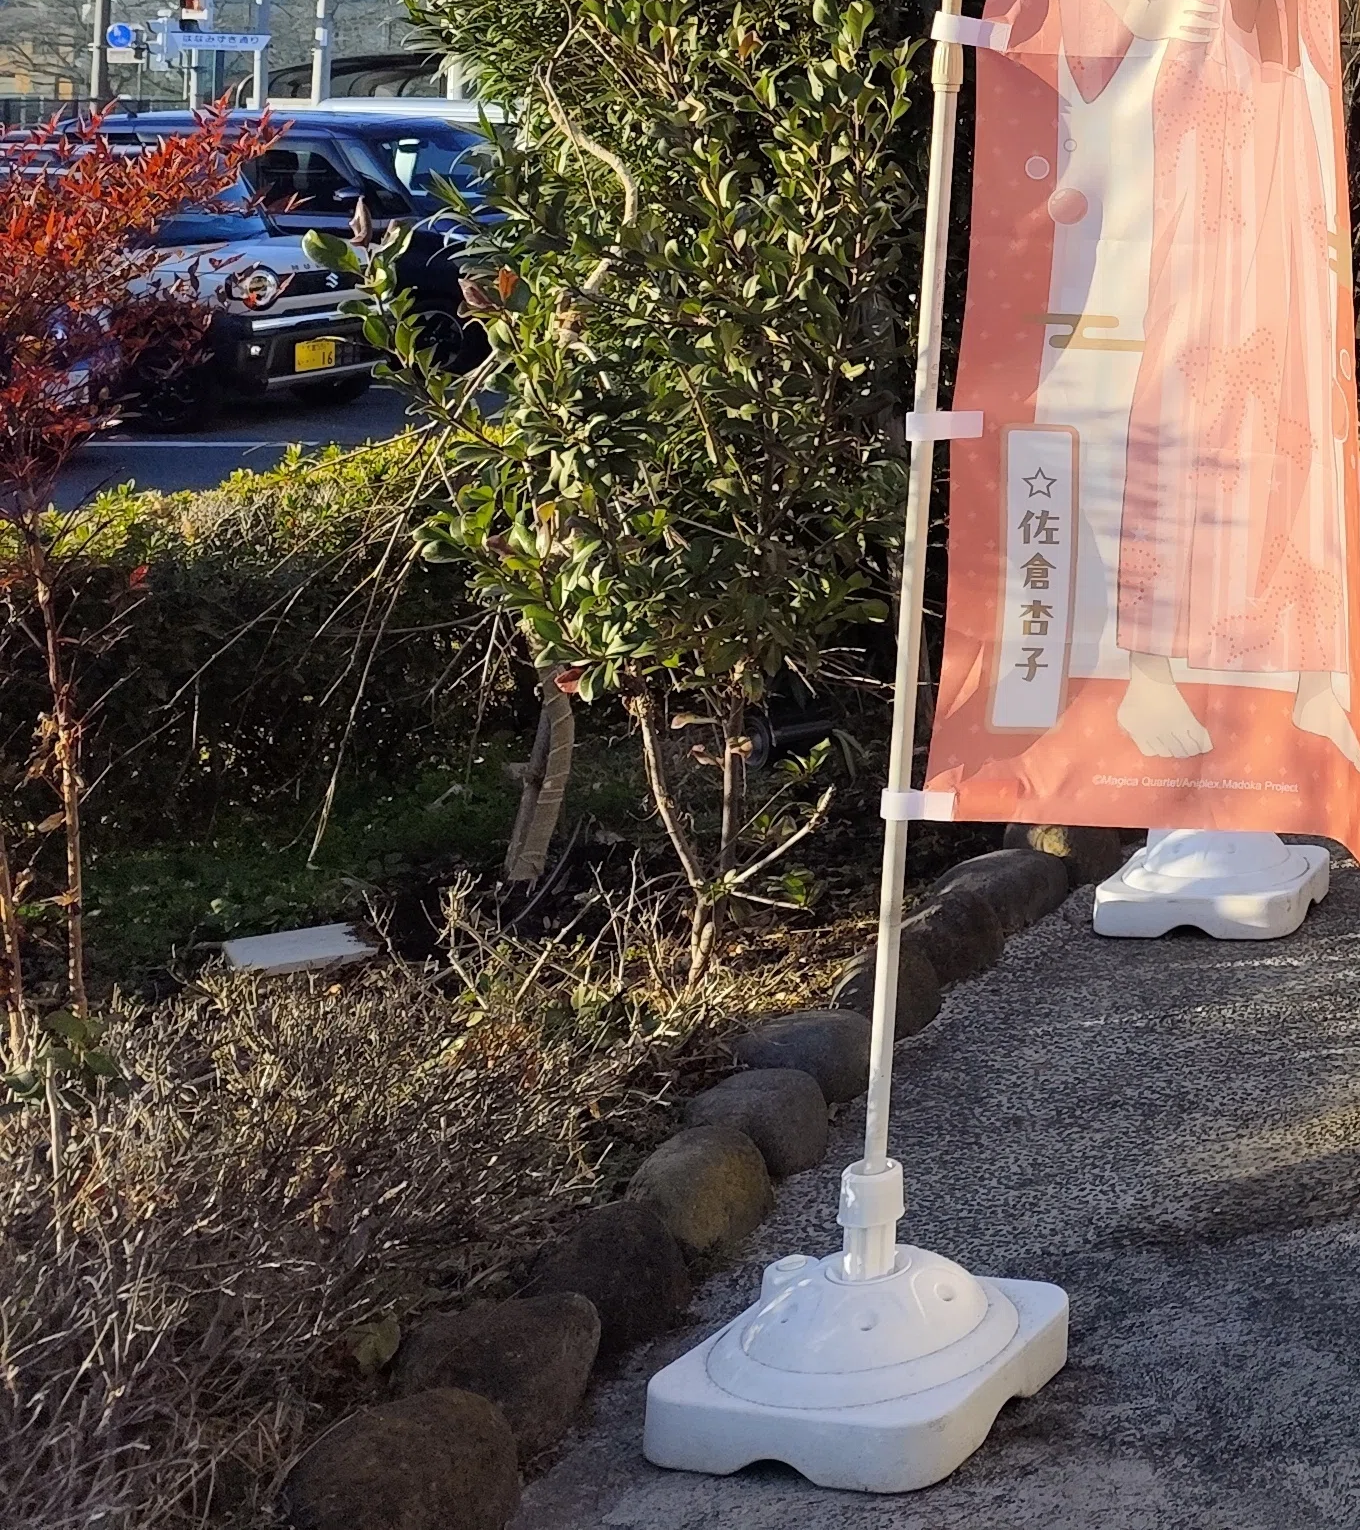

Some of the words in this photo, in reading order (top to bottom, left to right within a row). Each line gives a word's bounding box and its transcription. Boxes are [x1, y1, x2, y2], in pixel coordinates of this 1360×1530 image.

[183, 35, 259, 44] はなみずき通り
[1014, 509, 1061, 683] 佐倉杏子
[1265, 780, 1299, 793] Project
